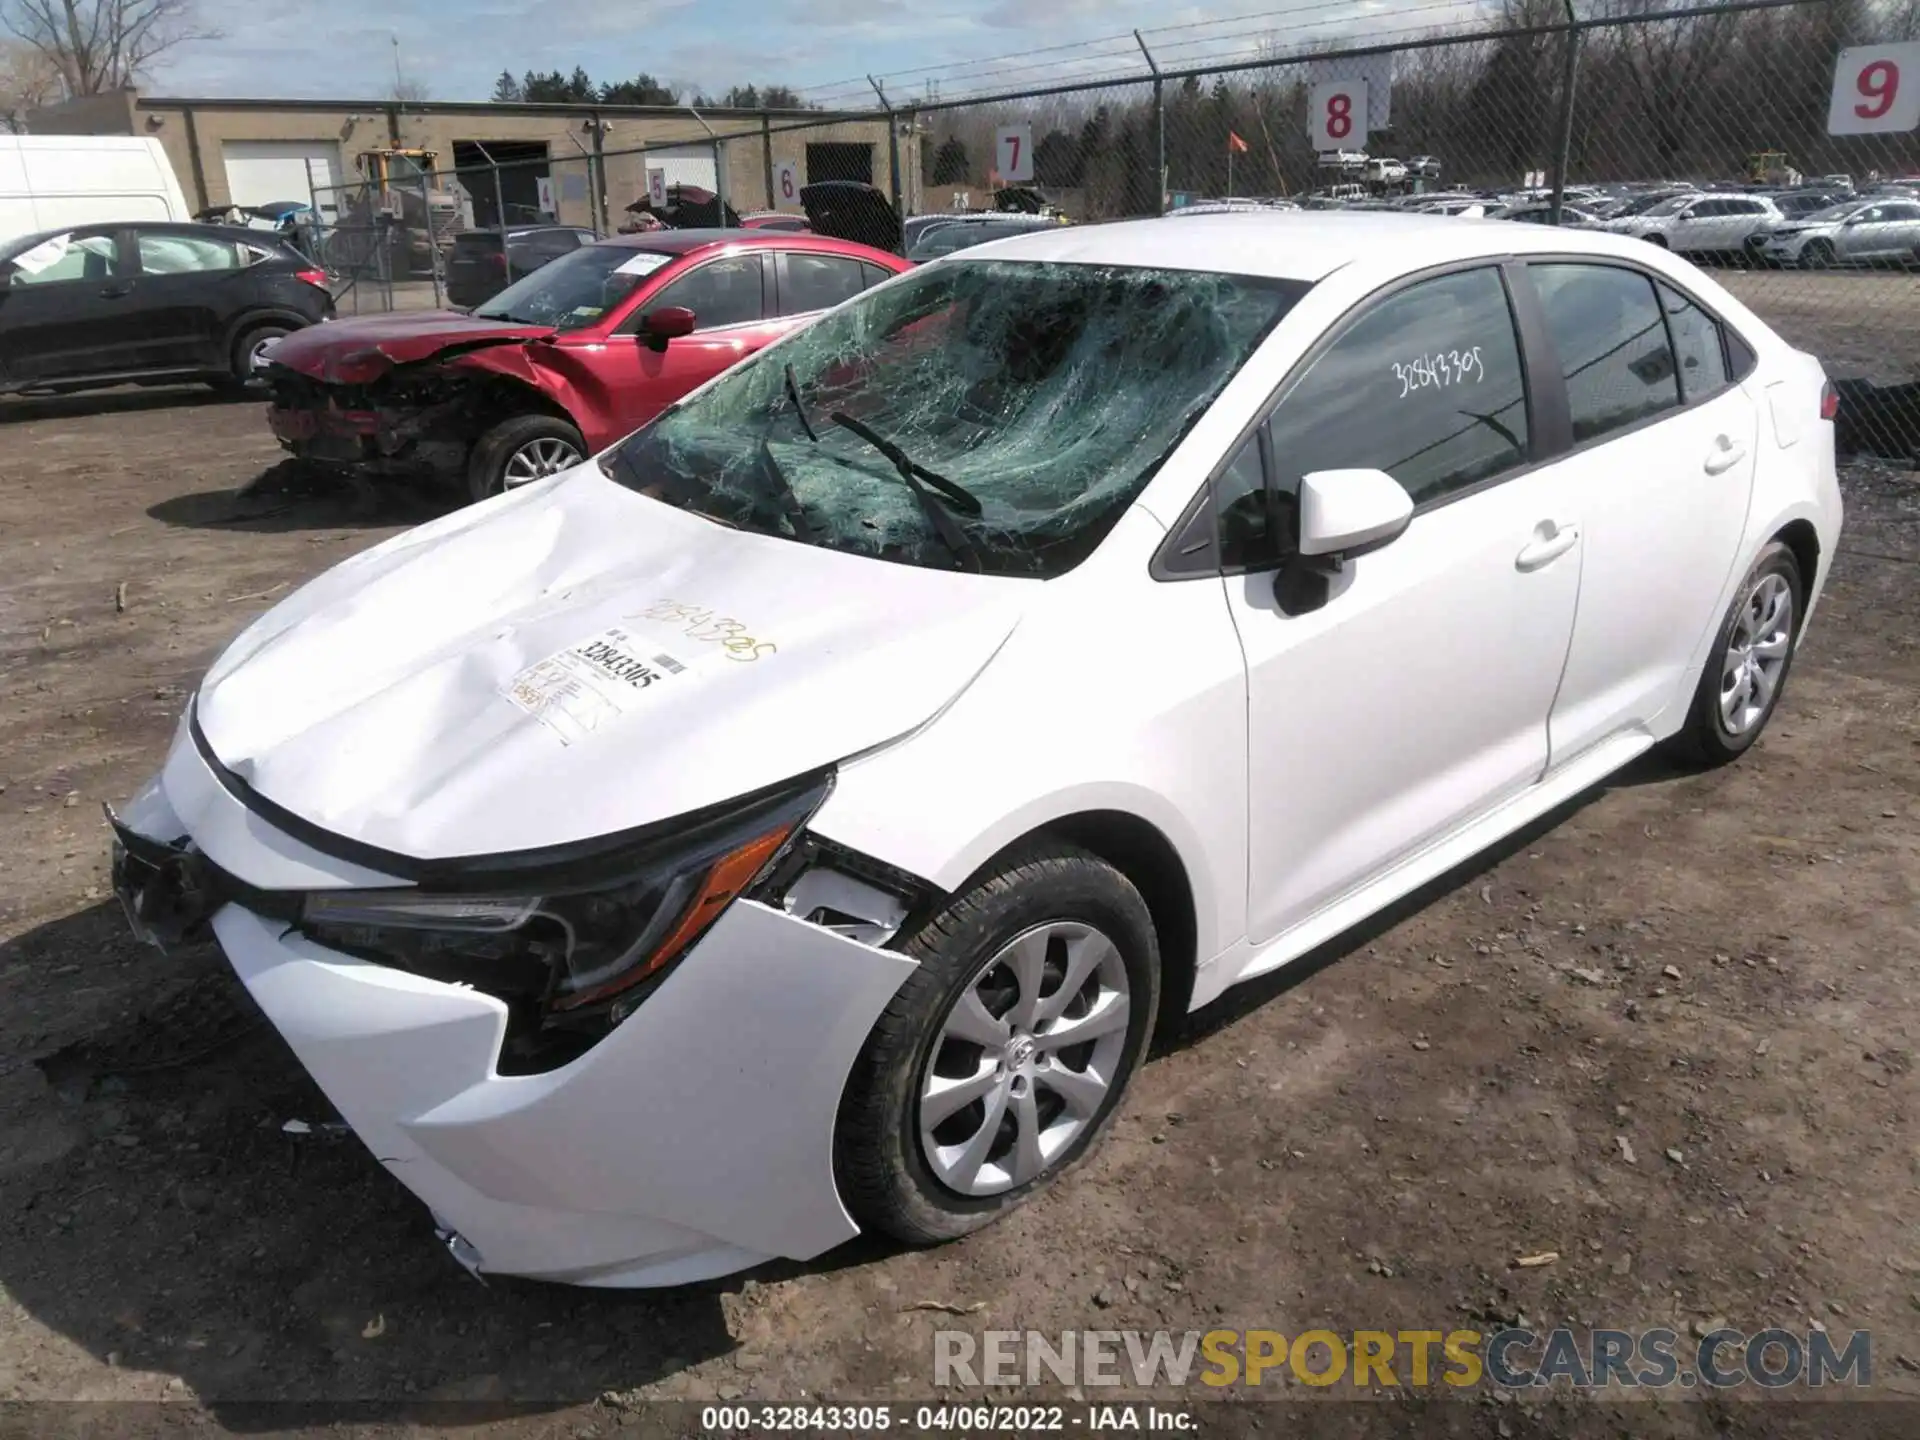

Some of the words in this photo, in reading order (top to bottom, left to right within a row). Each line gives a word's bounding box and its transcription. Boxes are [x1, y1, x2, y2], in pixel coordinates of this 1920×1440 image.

[1854, 60, 1900, 119] 9
[1326, 93, 1352, 138] 8
[1005, 136, 1020, 171] 7
[542, 183, 550, 205] 4
[652, 175, 662, 200] 5
[781, 168, 793, 198] 6
[1391, 346, 1484, 398] 32843305
[576, 640, 661, 689] 32843305
